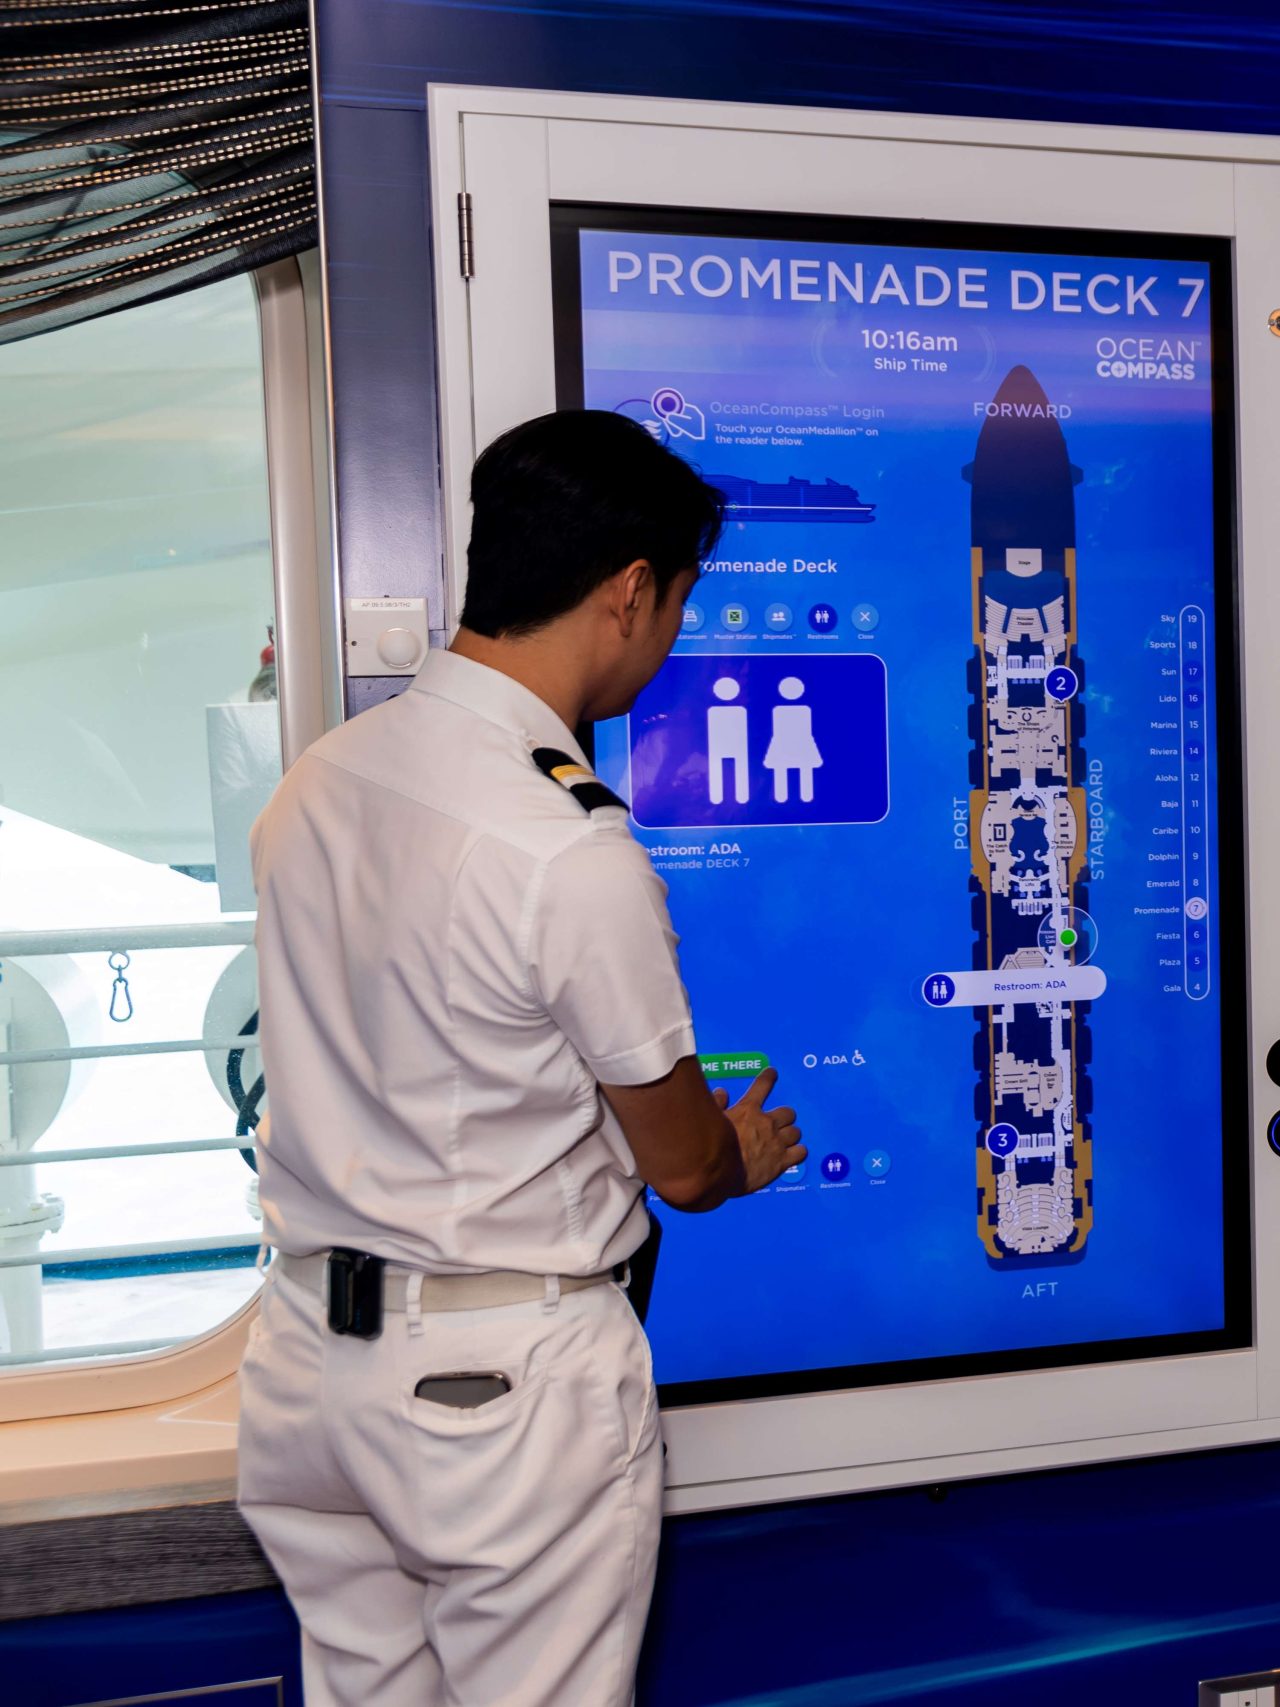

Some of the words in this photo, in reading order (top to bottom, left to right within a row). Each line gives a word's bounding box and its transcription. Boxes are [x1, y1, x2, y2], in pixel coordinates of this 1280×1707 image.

[608, 250, 988, 309] PROMENADE
[1010, 269, 1160, 317] DECK
[1178, 278, 1206, 318] 7
[861, 328, 958, 353] 10:16am
[873, 358, 905, 374] Ship
[910, 358, 948, 373] Time
[1096, 360, 1195, 380] COMPASS
[843, 405, 885, 420] Login
[973, 402, 1071, 419] FORWARD
[715, 423, 746, 433] Touch
[750, 425, 772, 435] your
[865, 428, 879, 436] on
[715, 435, 732, 444] the
[735, 435, 768, 445] reader
[771, 437, 804, 446] below.
[699, 559, 787, 573] omenade
[793, 559, 837, 573] Deck
[1160, 614, 1175, 624] Sky
[1187, 614, 1197, 623] 19
[1149, 641, 1176, 650] Sports
[1188, 641, 1197, 650] 18
[1161, 668, 1176, 676] Sun
[1188, 668, 1198, 676] 17
[1056, 676, 1066, 691] 2
[1159, 695, 1177, 703] Lido
[1188, 694, 1198, 703] 16
[1150, 721, 1177, 729] Marina
[1189, 721, 1198, 729] 15
[1150, 748, 1178, 756] Riviera
[1189, 747, 1199, 755] 14
[1155, 774, 1178, 782] Aloha
[1190, 773, 1199, 781] 12
[1161, 800, 1178, 809] Baja
[1191, 800, 1199, 808] 11
[953, 796, 969, 850] PORT
[1089, 759, 1104, 880] STARBOARD
[1152, 827, 1179, 835] Caribe
[1190, 826, 1200, 834] 10
[647, 844, 705, 857] stroom:
[708, 843, 742, 855] ADA
[1148, 853, 1179, 862] Dolphin
[1192, 852, 1199, 860] 9
[706, 858, 739, 869] DECK
[743, 858, 750, 867] 7
[1146, 879, 1180, 888] Emerald
[1193, 879, 1199, 887] 8
[1134, 905, 1180, 915] Promenade
[1193, 904, 1199, 912] 7
[1156, 932, 1180, 940] Fiesta
[1193, 931, 1200, 939] 6
[1159, 958, 1181, 967] Plaza
[1194, 957, 1200, 965] 5
[994, 982, 1043, 992] Restroom:
[1046, 980, 1067, 989] ADA
[1163, 984, 1181, 993] Gala
[1193, 983, 1201, 991] 4
[702, 1062, 719, 1072] ME
[722, 1059, 762, 1071] THERE
[823, 1056, 848, 1065] ADA
[998, 1133, 1008, 1147] 3
[820, 1181, 851, 1190] Restrooms
[1022, 1282, 1058, 1299] AFT
